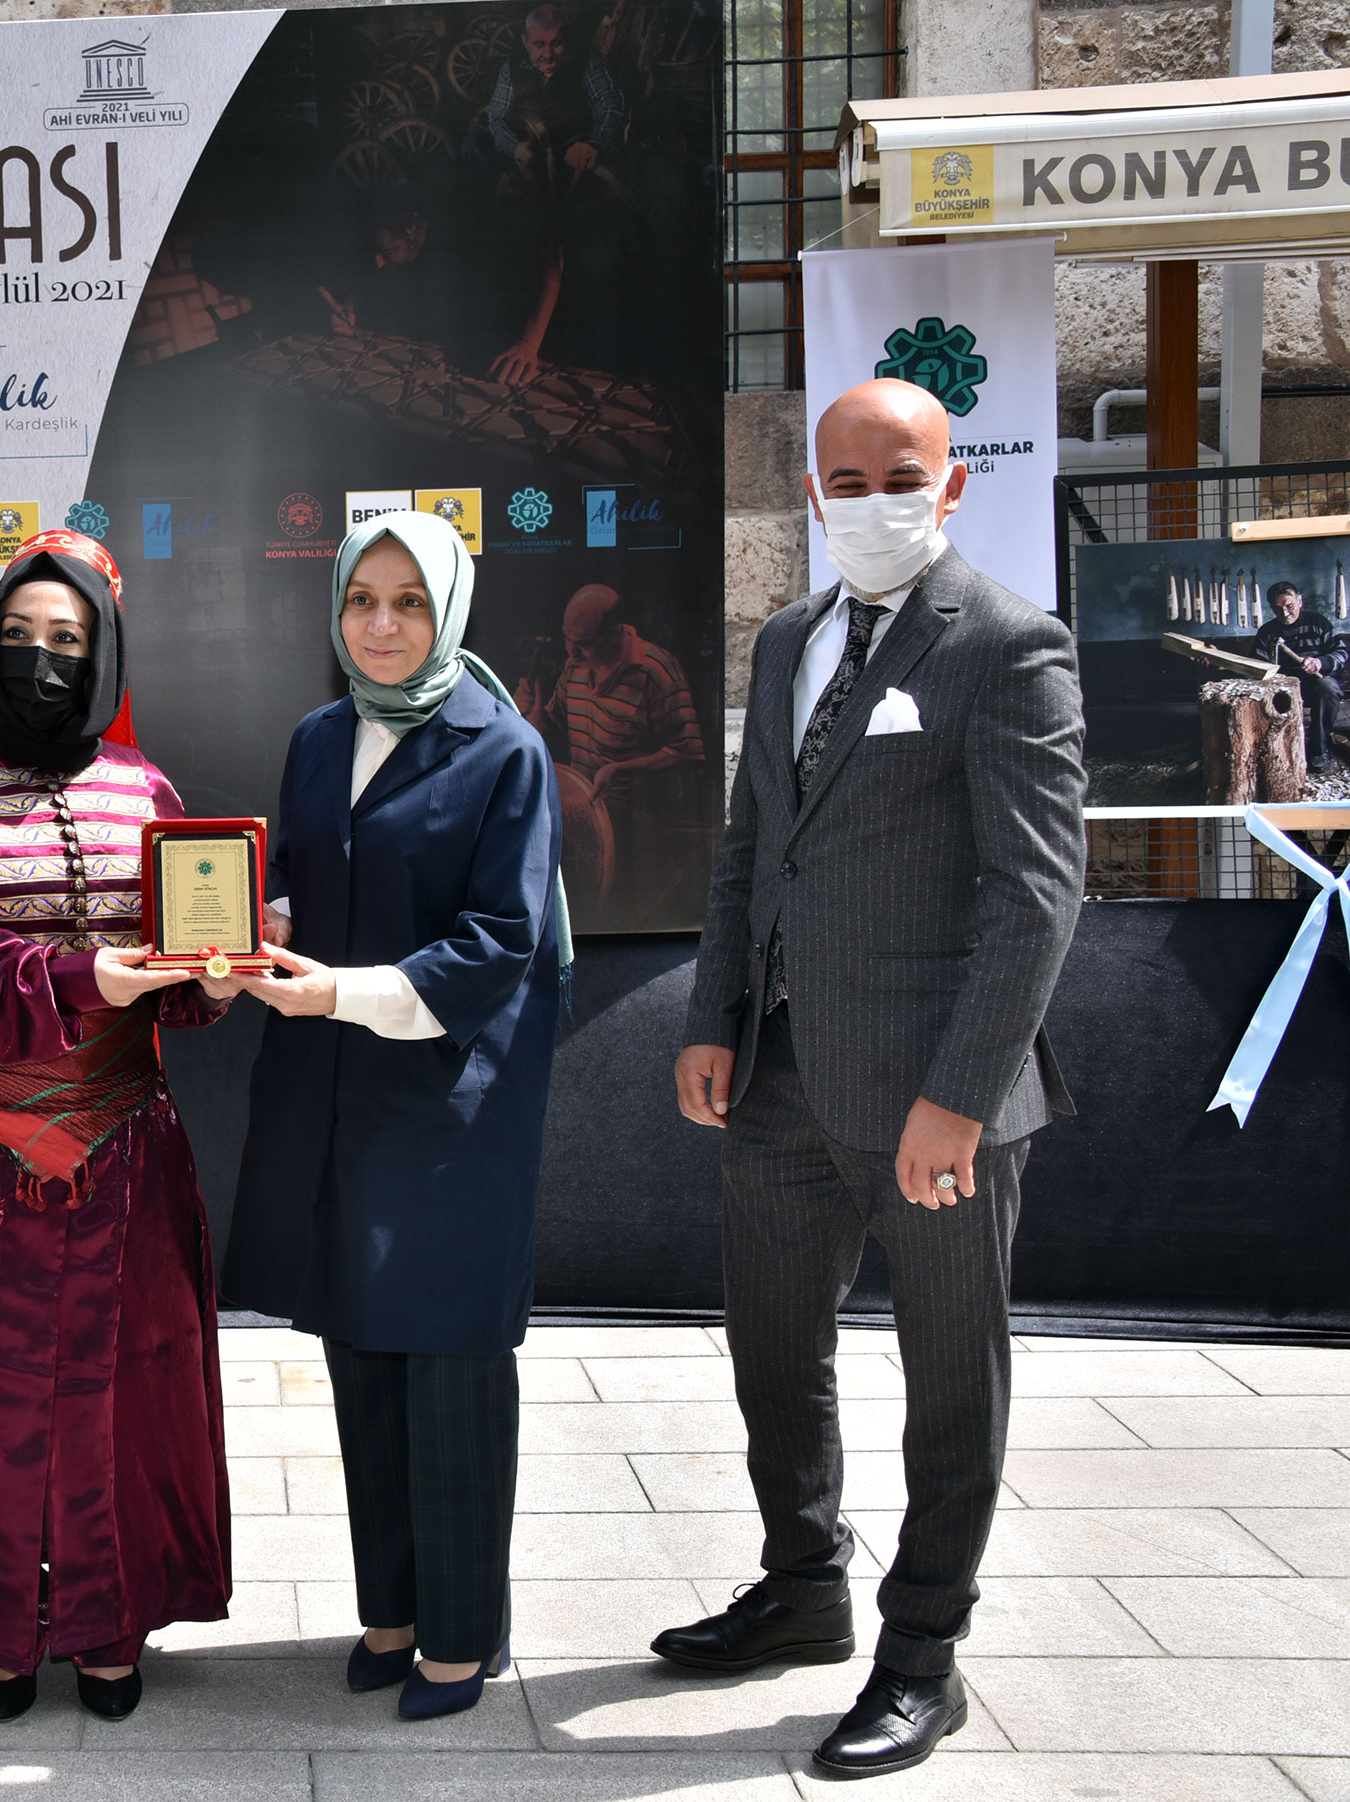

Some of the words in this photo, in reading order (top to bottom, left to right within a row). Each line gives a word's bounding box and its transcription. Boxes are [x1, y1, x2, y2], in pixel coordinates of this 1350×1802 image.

[85, 57, 144, 89] UNESCO
[102, 102, 130, 113] 2021
[50, 112, 72, 126] AHİ
[130, 109, 156, 122] VELİ
[159, 110, 183, 121] YILI
[1022, 145, 1261, 206] KONYA
[934, 188, 971, 198] KONYA
[915, 196, 990, 212] BÜYÜKŞEHİR
[930, 212, 975, 220] BELEDİYESİ
[50, 279, 128, 302] 2021
[5, 417, 79, 432] Kardeşlik
[265, 550, 297, 559] KONYA
